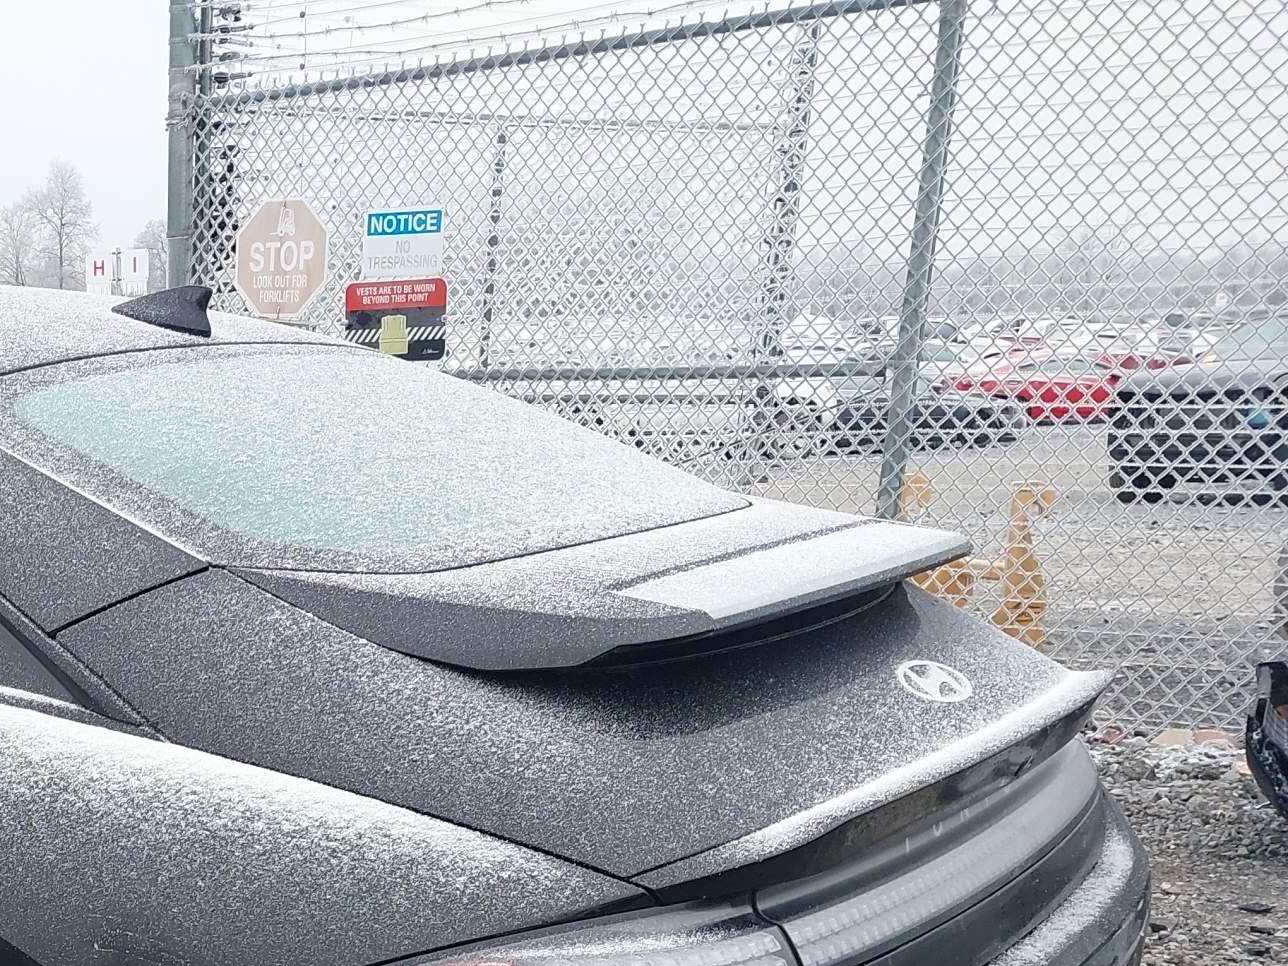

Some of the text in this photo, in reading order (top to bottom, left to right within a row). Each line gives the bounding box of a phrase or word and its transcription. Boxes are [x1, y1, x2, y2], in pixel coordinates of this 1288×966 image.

[370, 213, 438, 233] NOTICE
[395, 240, 411, 254] NO
[249, 240, 316, 273] STOP
[368, 255, 438, 270] TRESPASSING
[93, 260, 105, 276] H
[253, 274, 308, 289] LOOK OUT FOR
[259, 289, 300, 303] FORKLIFTS
[356, 283, 436, 296] VESTS ARE TO BE WORN
[362, 292, 429, 304] BEYOND THIS POINT
